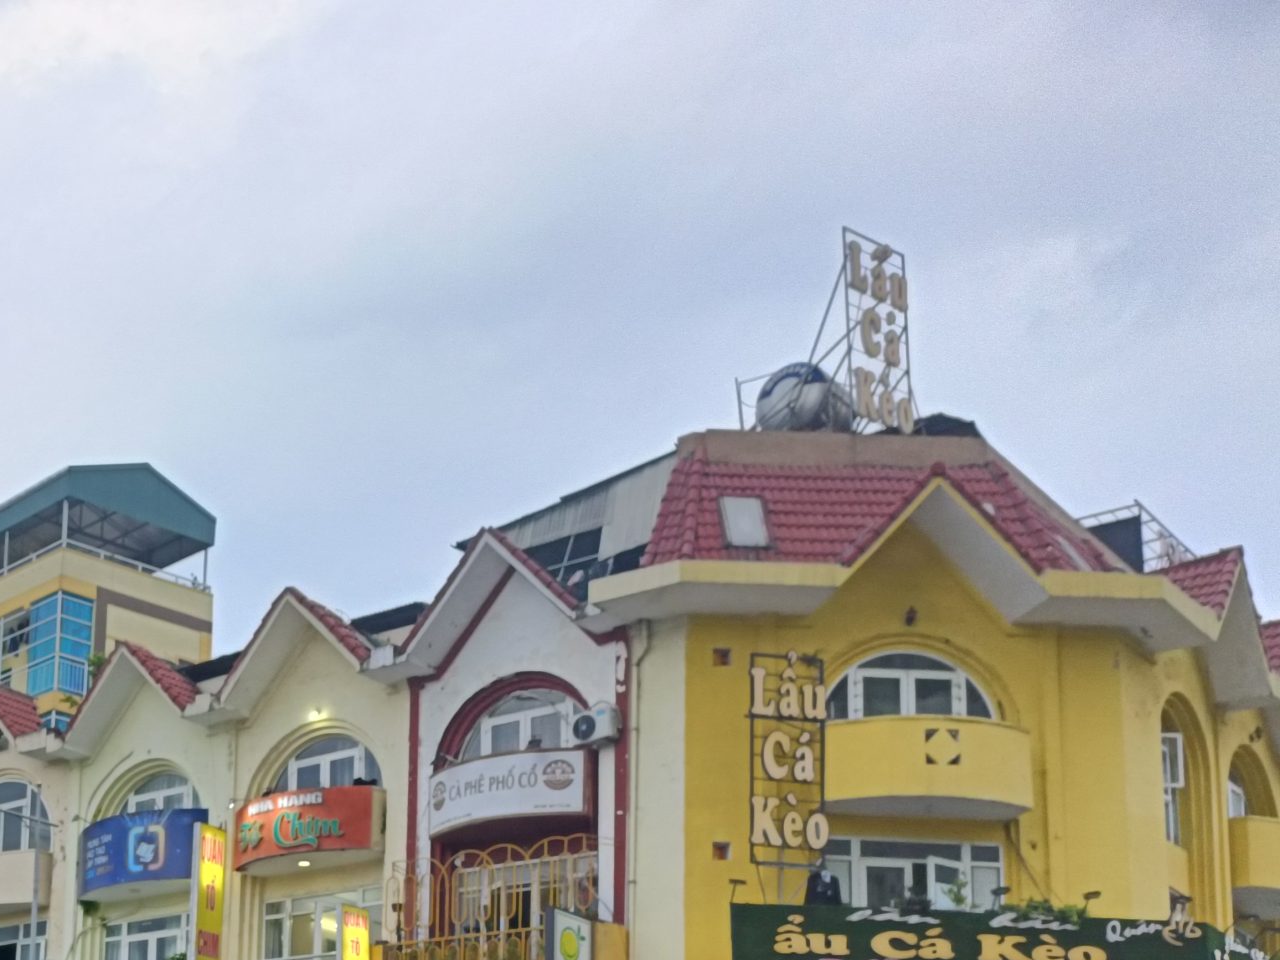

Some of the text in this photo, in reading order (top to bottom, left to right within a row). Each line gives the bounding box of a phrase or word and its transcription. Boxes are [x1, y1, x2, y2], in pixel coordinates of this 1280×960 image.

[751, 650, 827, 720] Lẩu
[763, 731, 815, 782] Cá
[448, 779, 462, 801] CÀ
[464, 774, 485, 797] PHÊ
[273, 810, 345, 848] Chim
[751, 793, 829, 849] Kèo
[871, 927, 955, 960] Cá
